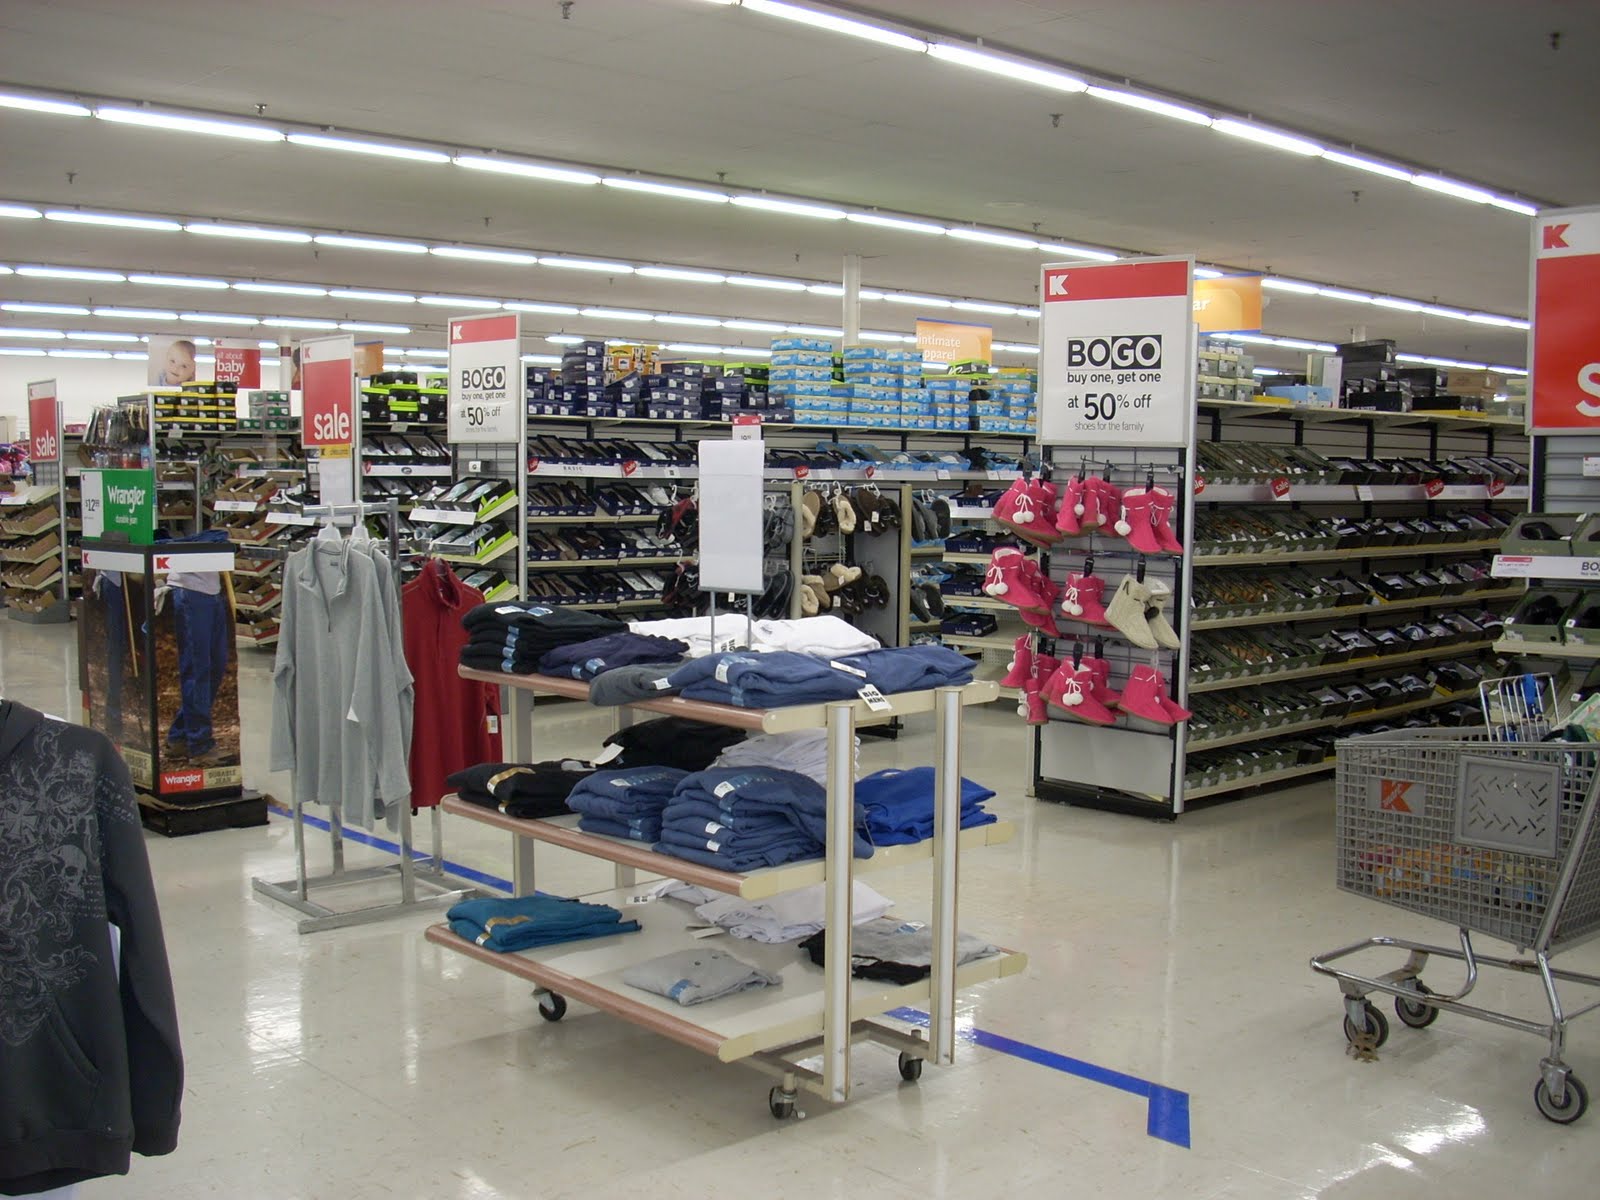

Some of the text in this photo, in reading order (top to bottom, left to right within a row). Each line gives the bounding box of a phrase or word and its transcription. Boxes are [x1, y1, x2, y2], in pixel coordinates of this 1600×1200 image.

[1543, 223, 1569, 249] K
[1050, 274, 1068, 295] K
[453, 325, 462, 340] K
[918, 333, 961, 348] intimate
[923, 349, 956, 360] pparel
[1067, 336, 1161, 368] BOGO
[217, 359, 245, 376] baby
[462, 367, 505, 389] BOGO
[1067, 371, 1161, 385] buy one, get one
[462, 391, 471, 402] buy
[485, 390, 495, 401] get
[496, 390, 506, 399] one
[492, 406, 502, 416] off
[1067, 393, 1152, 420] at 50% off
[313, 403, 350, 440] sale
[1075, 421, 1144, 432] shoes for the family
[36, 429, 56, 457] sale
[1275, 481, 1289, 492] sale
[107, 485, 146, 514] Wrangler
[83, 552, 89, 564] K
[156, 557, 170, 569] K
[1581, 561, 1600, 572] BO
[862, 690, 879, 698] BIG
[164, 774, 202, 786] Wrangler
